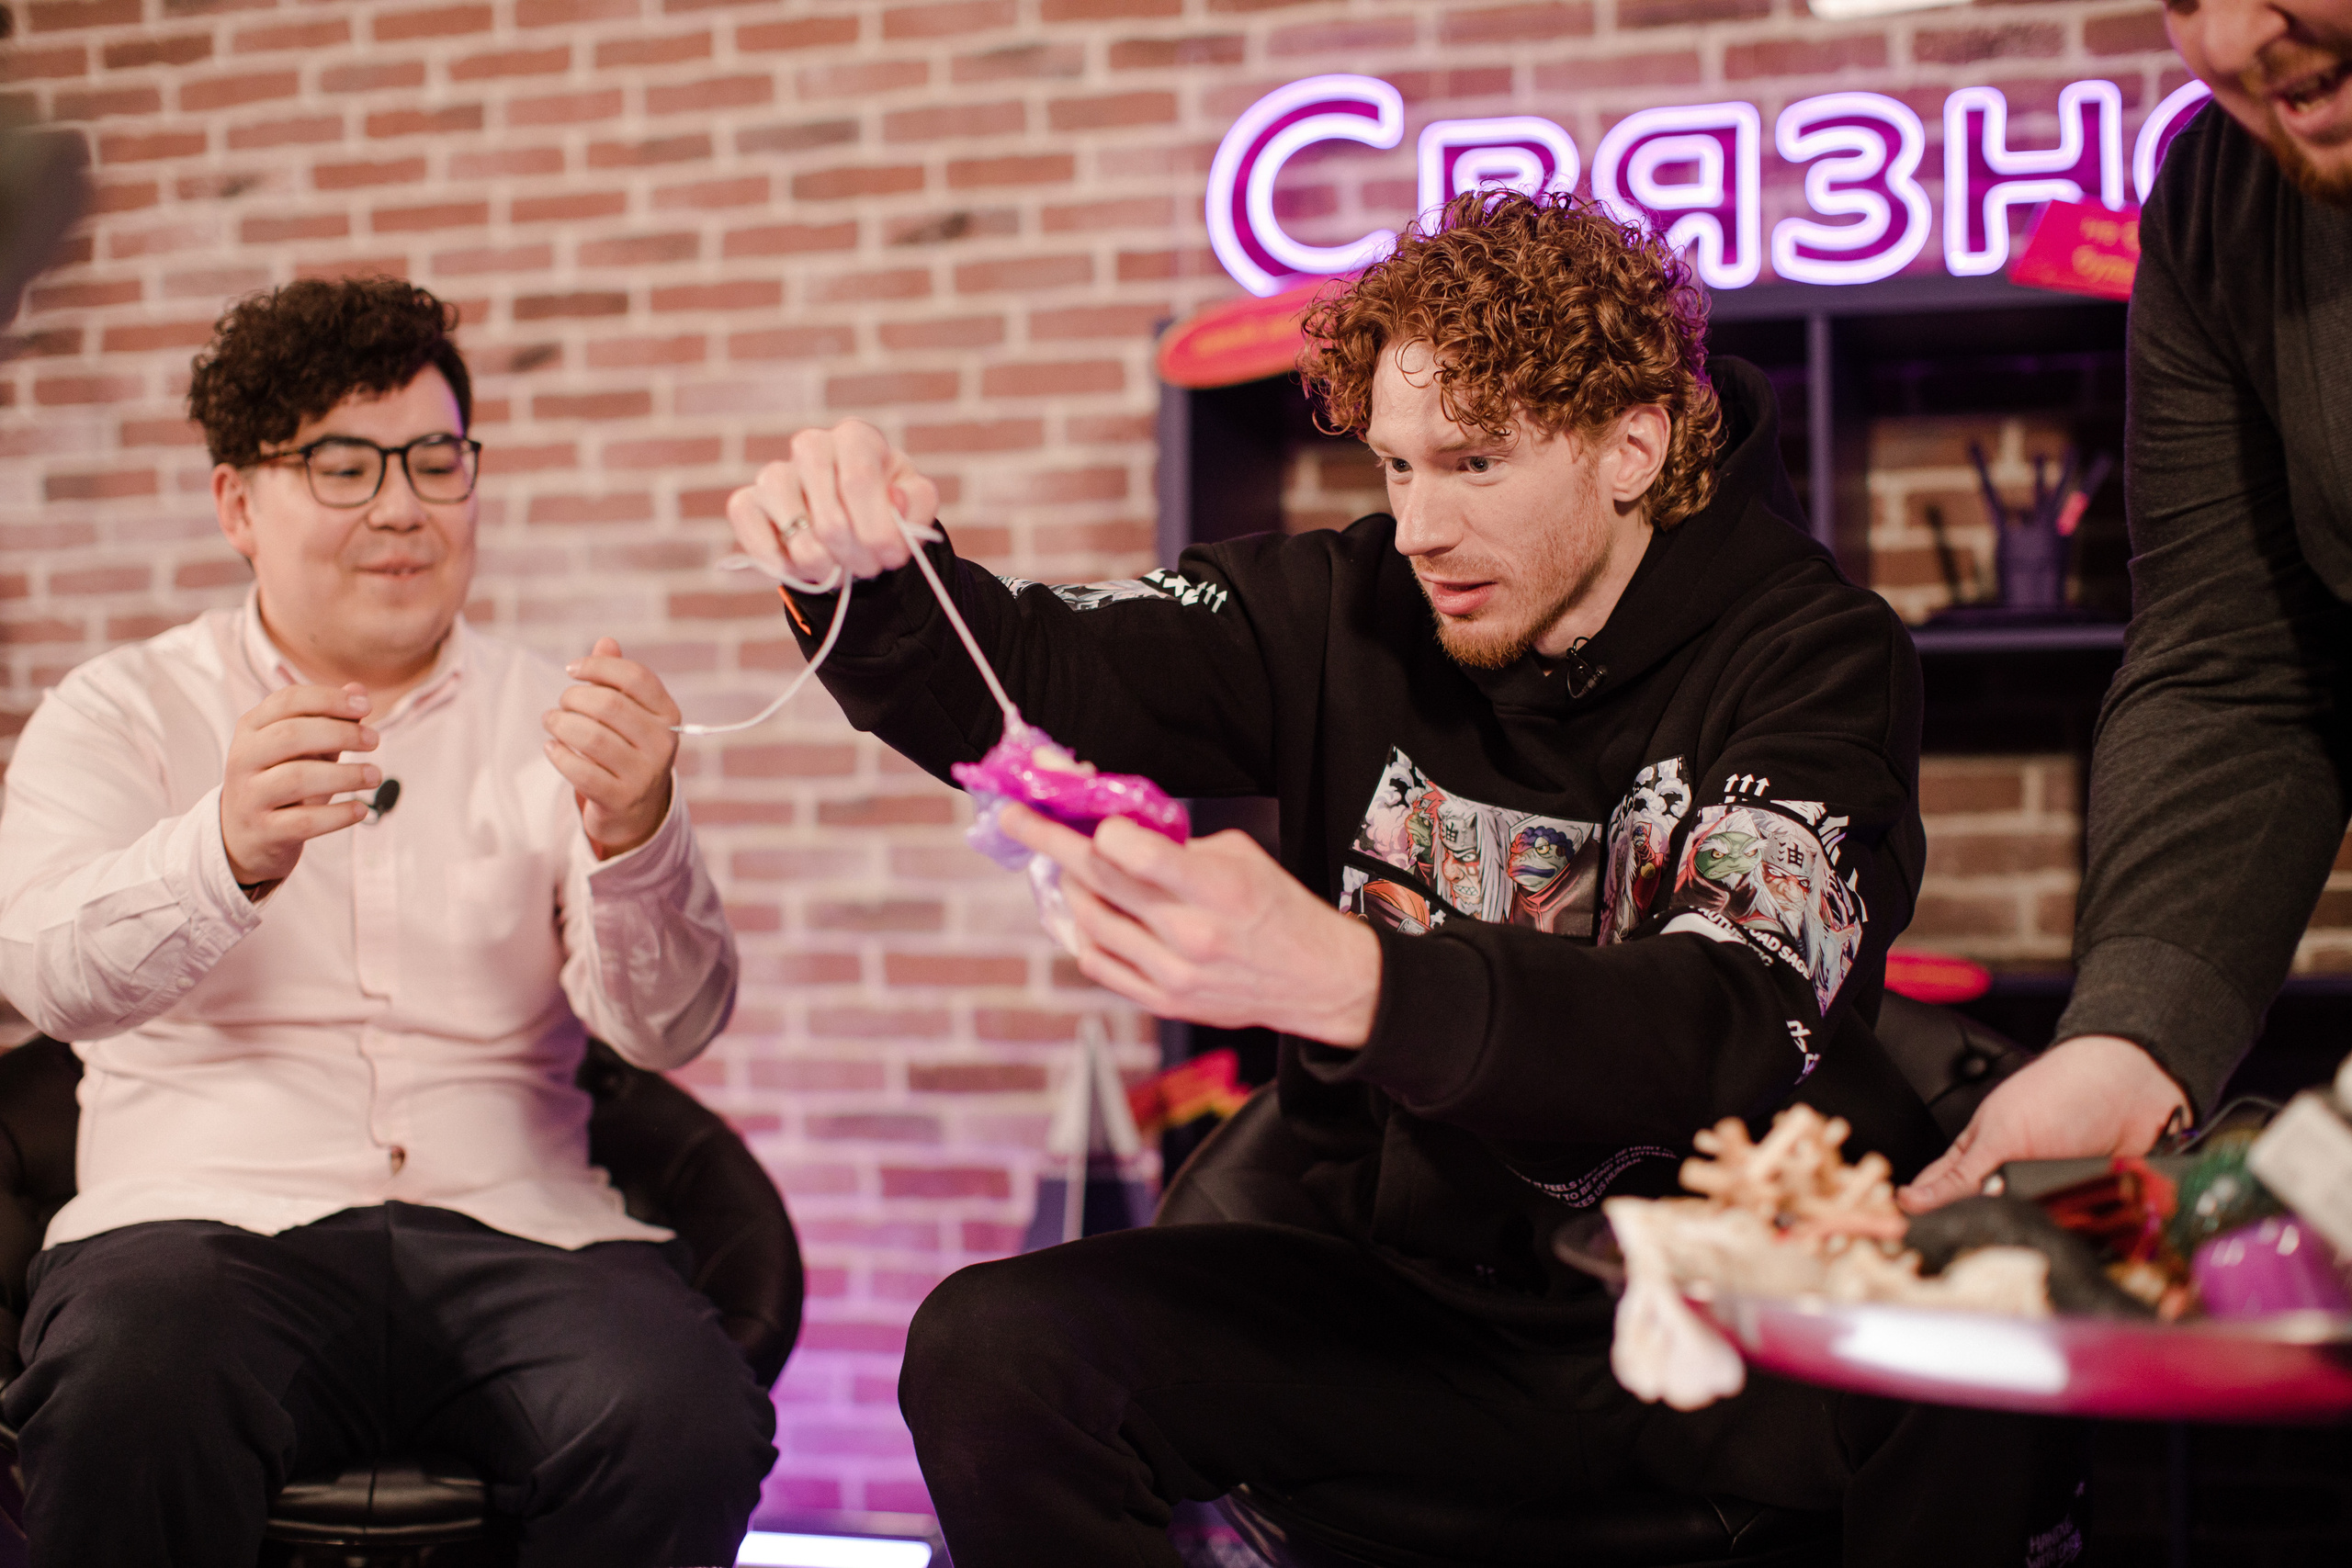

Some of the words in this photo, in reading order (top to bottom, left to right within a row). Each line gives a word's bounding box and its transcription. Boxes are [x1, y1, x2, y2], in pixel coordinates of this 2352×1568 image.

[1206, 73, 2212, 299] Связн
[1698, 908, 1774, 966] AUTHETIC
[1744, 927, 1781, 953] OAD
[1778, 945, 1812, 980] SAGE
[1544, 1181, 1577, 1192] FEELS
[1563, 1192, 1579, 1201] TO
[1579, 1181, 1593, 1196] BE
[1591, 1163, 1613, 1184] KIND
[1614, 1155, 1629, 1165] TO
[1594, 1181, 1607, 1196] US
